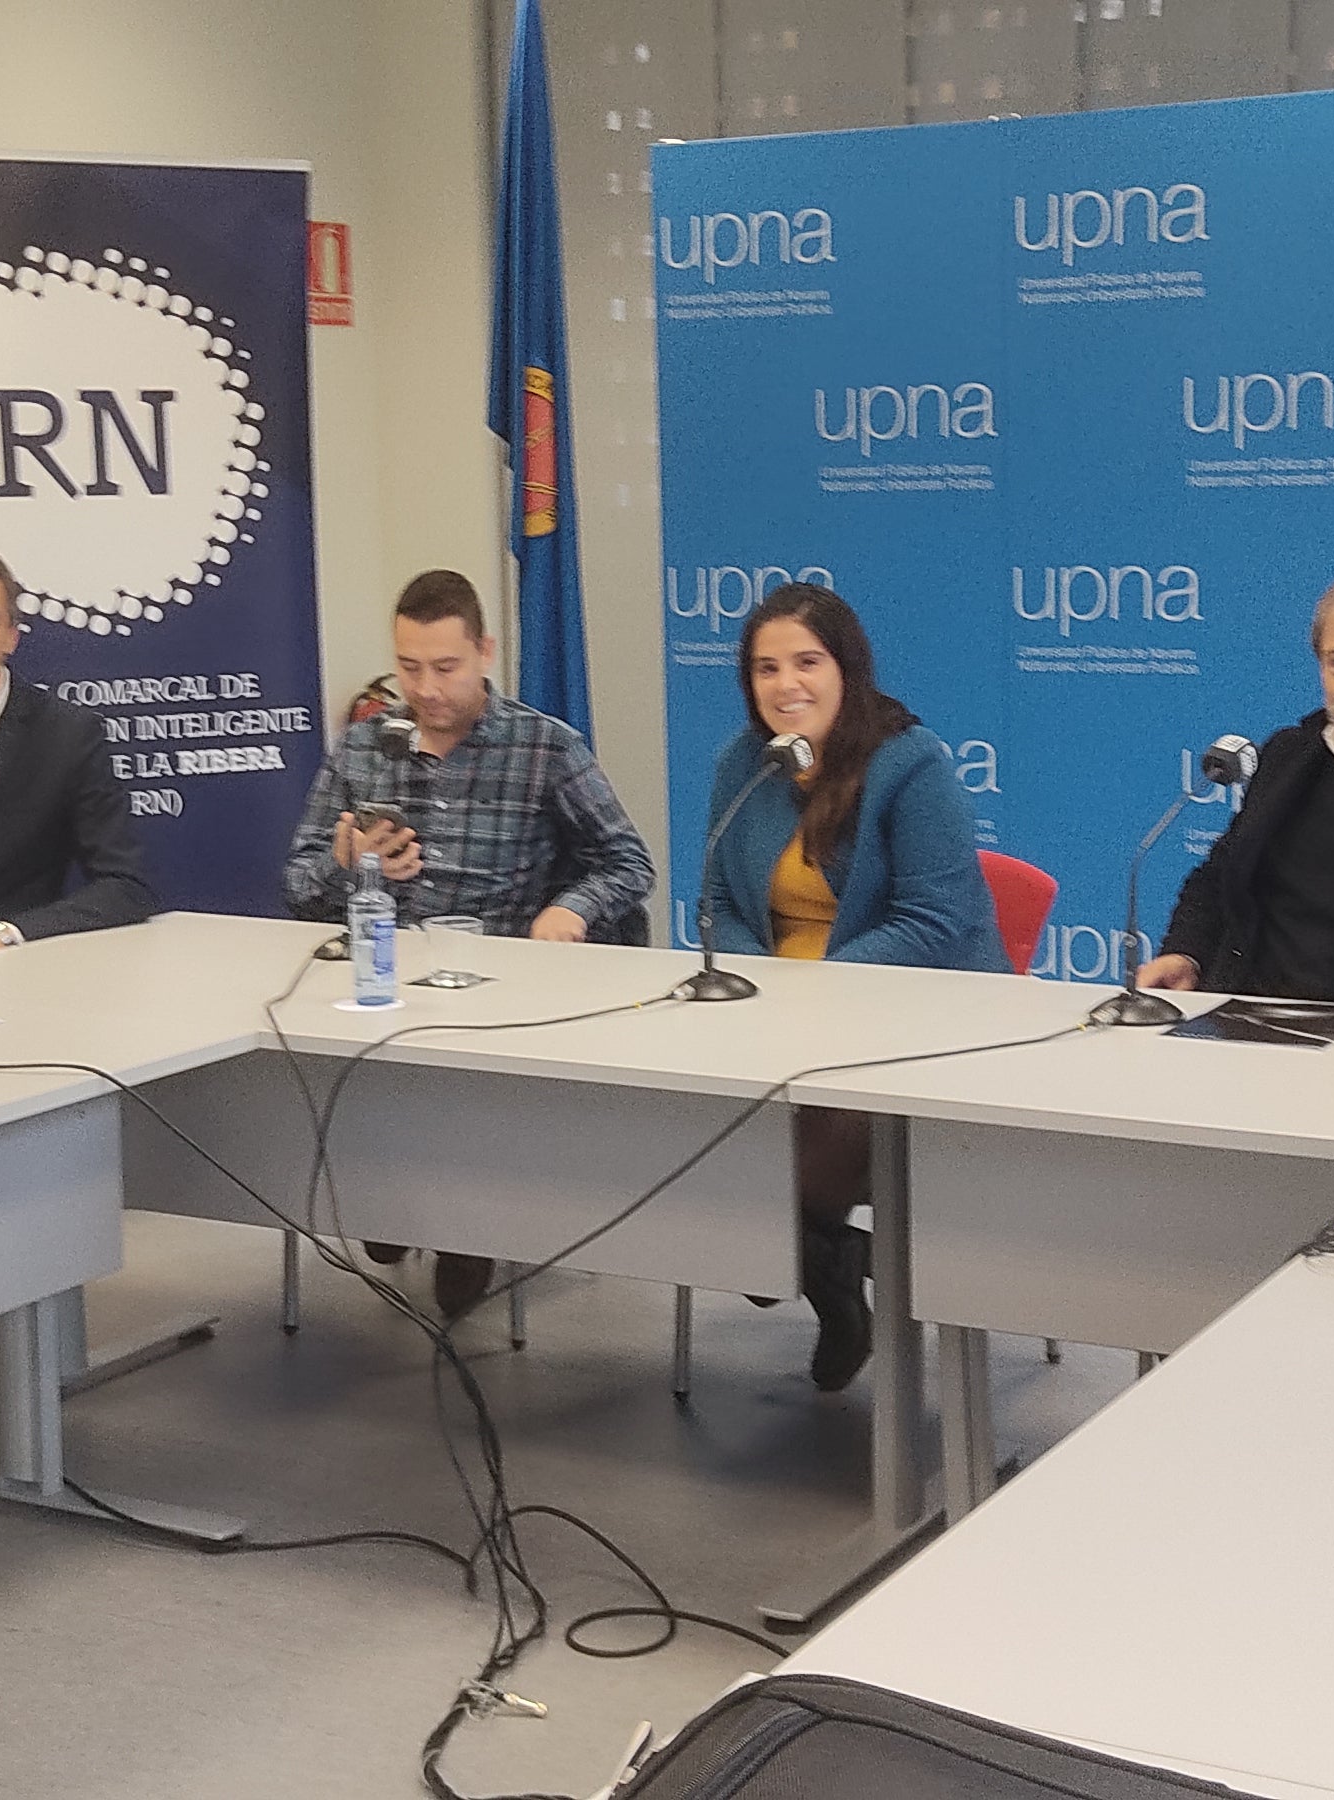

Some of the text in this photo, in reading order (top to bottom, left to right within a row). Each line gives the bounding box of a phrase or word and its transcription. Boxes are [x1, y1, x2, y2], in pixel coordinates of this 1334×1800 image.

[659, 207, 837, 285] upna
[1014, 183, 1210, 267] upna
[815, 381, 999, 458] upna
[1012, 564, 1205, 637] upna
[56, 672, 262, 707] COMARCAL DE
[133, 706, 313, 741] INTELIGENTE
[134, 751, 176, 778] LA
[174, 744, 286, 776] RIBERA
